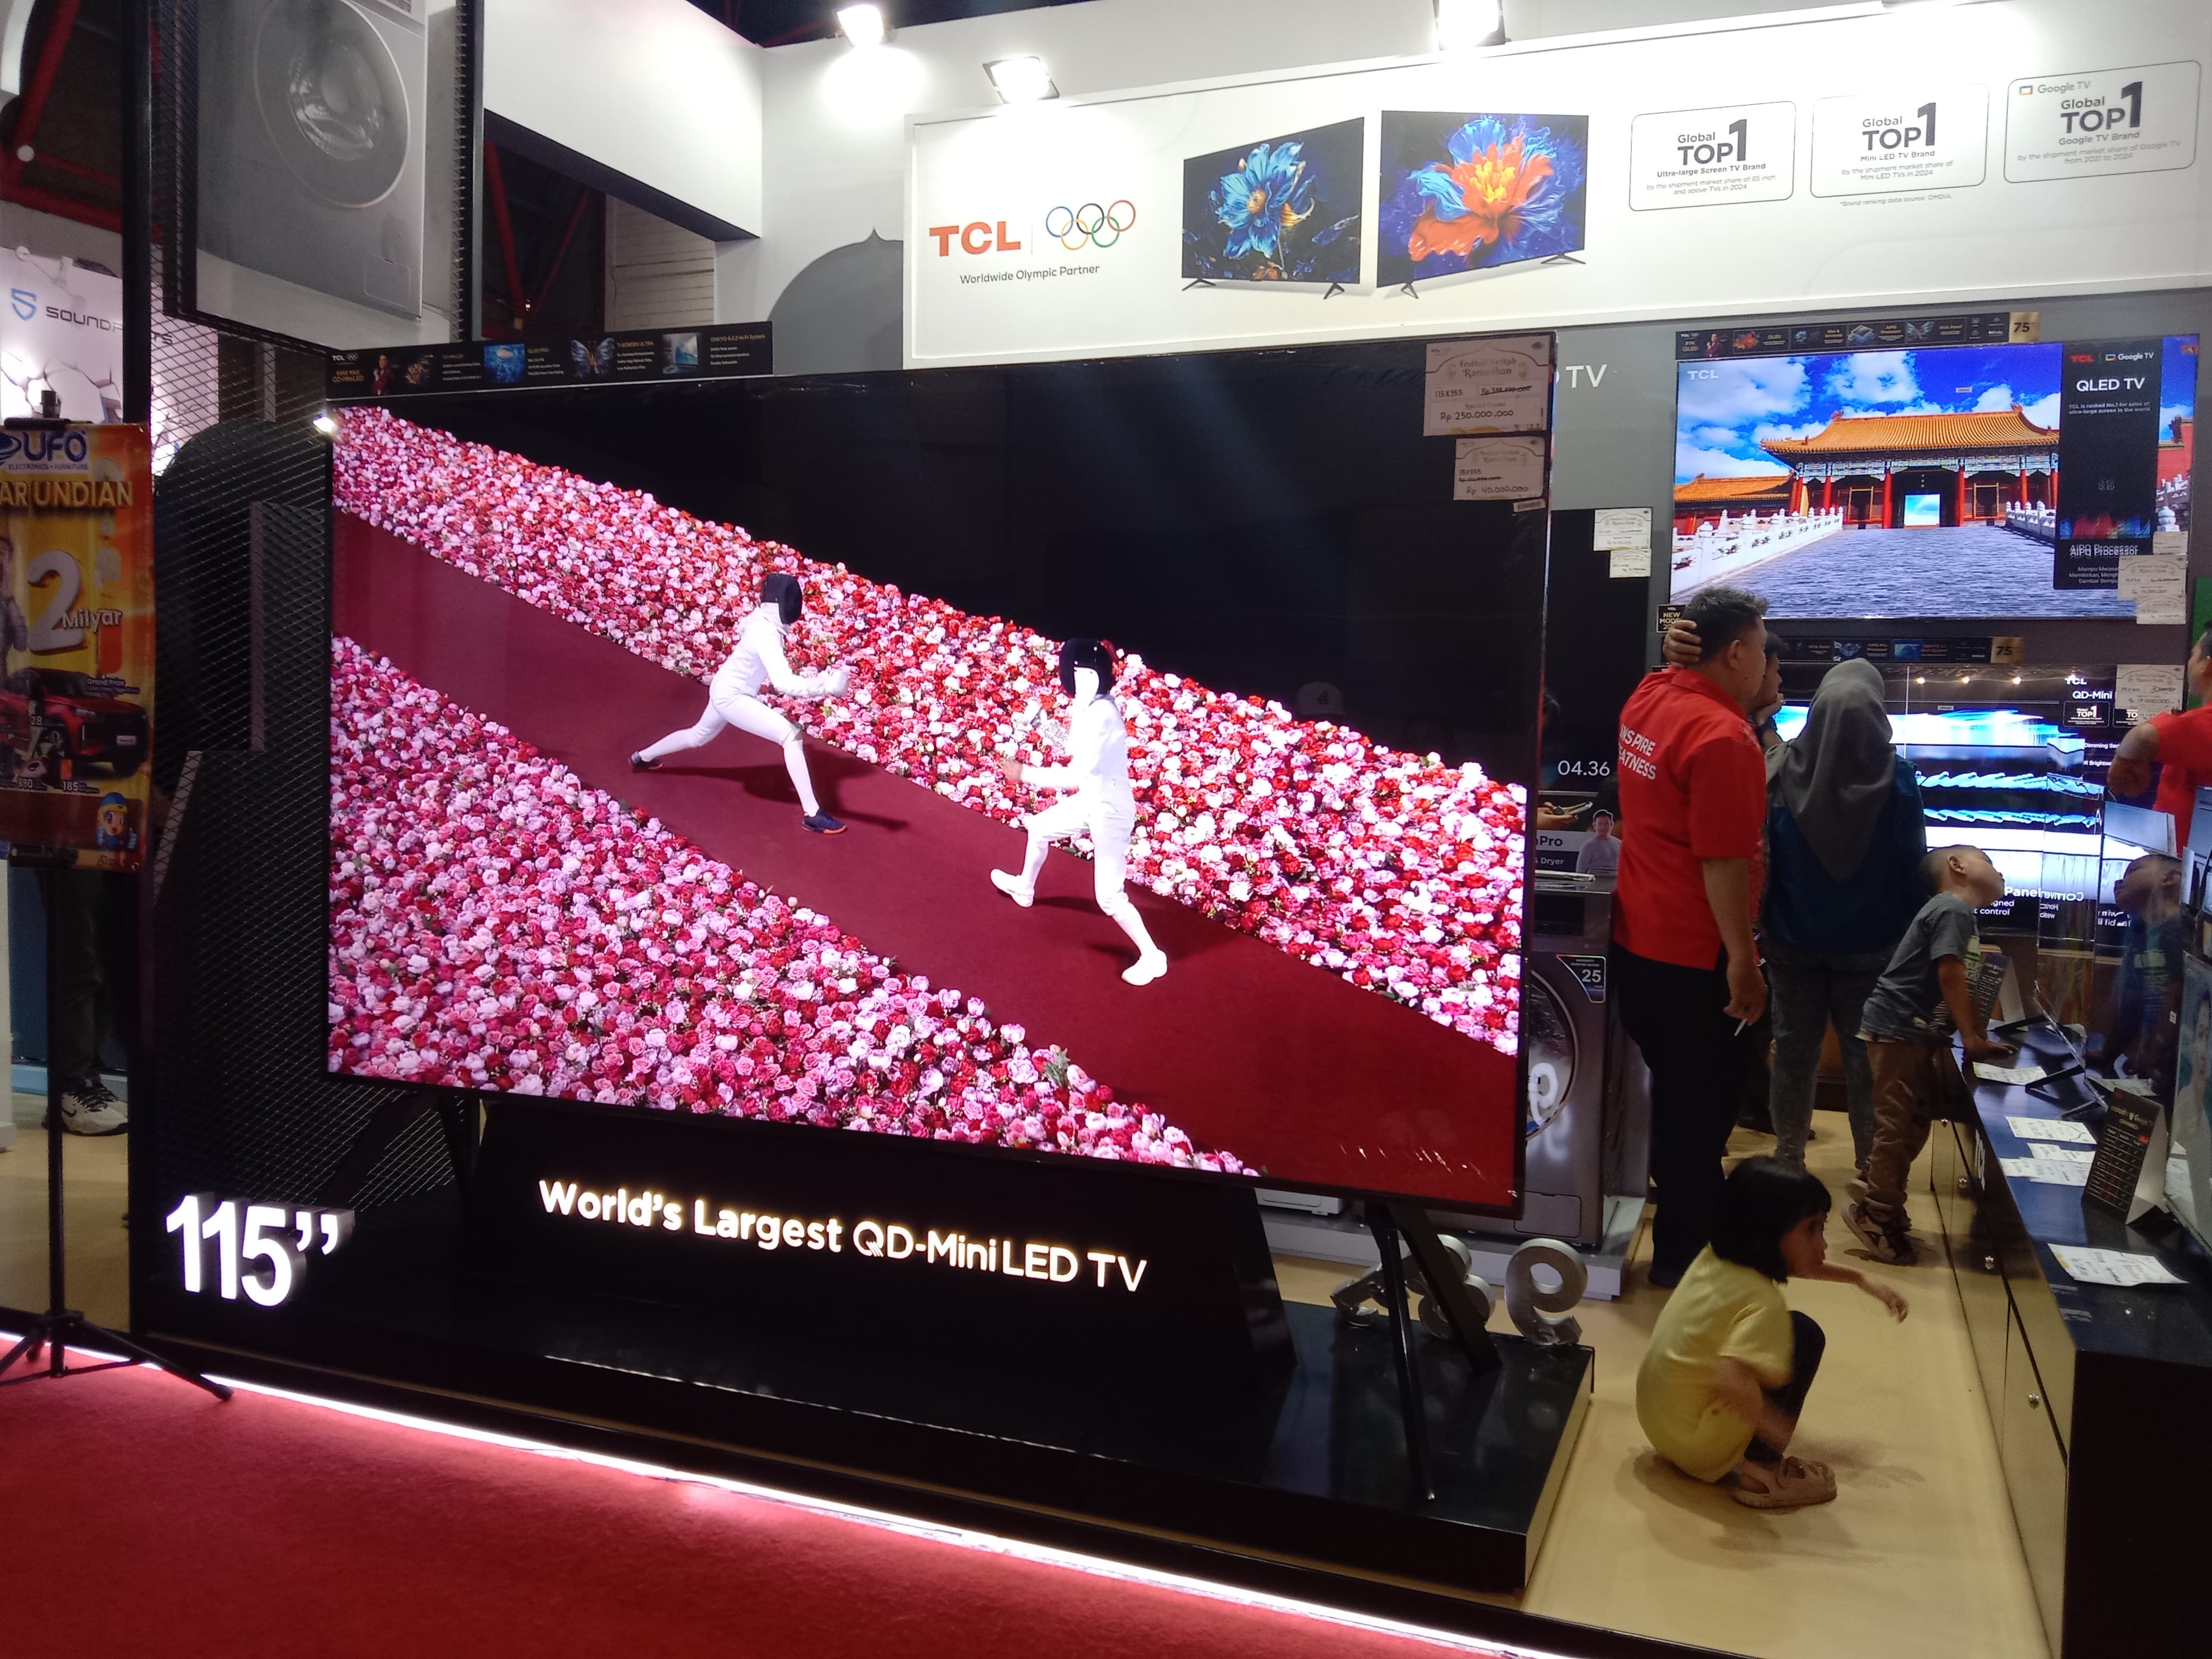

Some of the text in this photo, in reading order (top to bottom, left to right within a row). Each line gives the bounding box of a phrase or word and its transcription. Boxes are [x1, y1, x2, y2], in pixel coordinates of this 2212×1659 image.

[2037, 80, 2092, 95] Google TV
[2060, 96, 2105, 110] Global
[1862, 115, 1903, 128] Global
[1677, 131, 1716, 144] Global
[2058, 135, 2093, 146] Google
[2111, 131, 2140, 140] Brand
[1911, 150, 1936, 158] Brand
[2042, 150, 2077, 160] shipment
[2140, 142, 2168, 150] Google
[1657, 169, 1698, 178] Ultra-large
[1865, 165, 1897, 173] shipment
[929, 220, 1021, 257] TCL
[959, 264, 1100, 284] Worldwide Olympic Partner
[2071, 354, 2095, 363] TCL
[2117, 353, 2143, 361] Google
[1565, 364, 1607, 388] TV
[1687, 370, 1719, 380] TCL
[2075, 378, 2146, 392] QLED TV
[1440, 410, 1514, 423] Rp 250.000.000
[22, 429, 87, 462] UFO
[33, 481, 134, 507] UNDIAN
[28, 550, 83, 652] 2
[62, 608, 123, 633] Milyar
[1996, 646, 2013, 656] 75
[2064, 676, 2088, 685] TCL
[2072, 690, 2113, 700] QD-Mini
[1557, 760, 1611, 777] 04.36
[62, 781, 79, 791] 185
[1540, 857, 1564, 866] Dryer
[2004, 886, 2042, 898] Panel
[1581, 969, 1602, 983] 25
[538, 1178, 683, 1231] World's
[693, 1198, 843, 1252] Largest
[1087, 1251, 1147, 1293] TV
